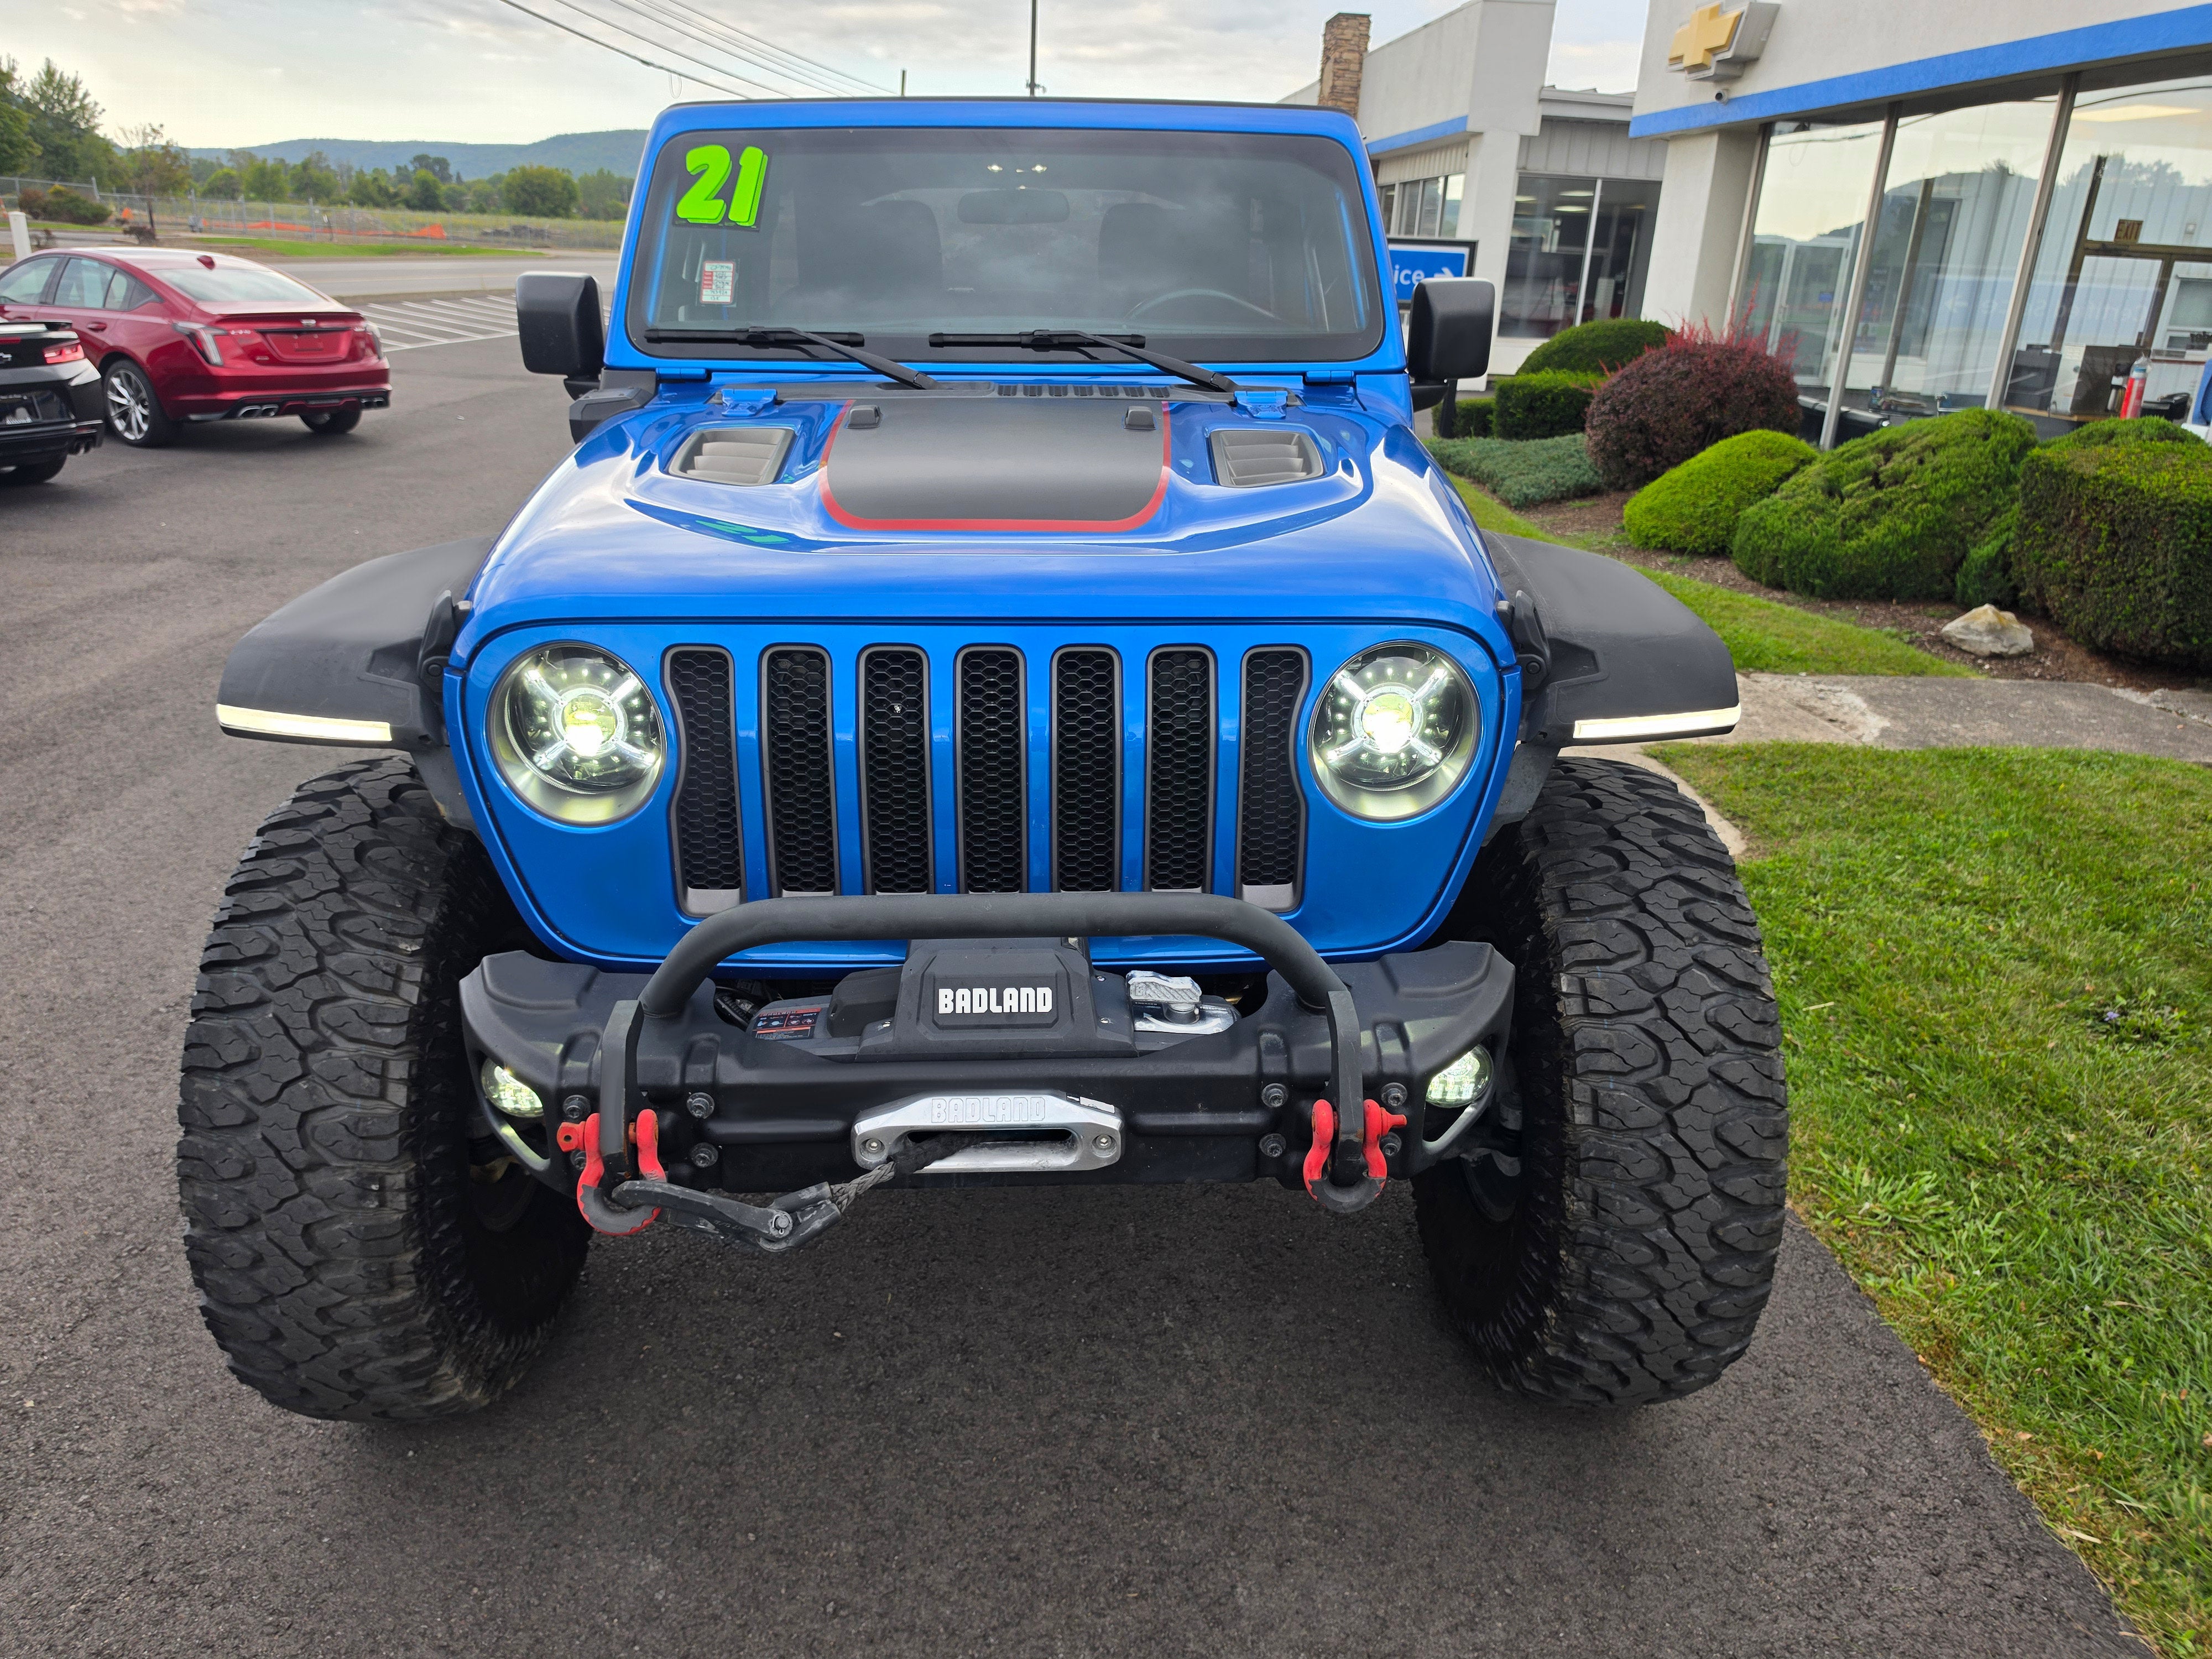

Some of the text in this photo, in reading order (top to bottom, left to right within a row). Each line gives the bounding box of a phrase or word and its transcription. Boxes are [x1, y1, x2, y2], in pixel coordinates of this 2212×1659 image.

[676, 144, 768, 226] 21
[2115, 221, 2142, 240] EXIT
[938, 987, 1052, 1014] BADLAND
[931, 1097, 1046, 1123] BADLAND
